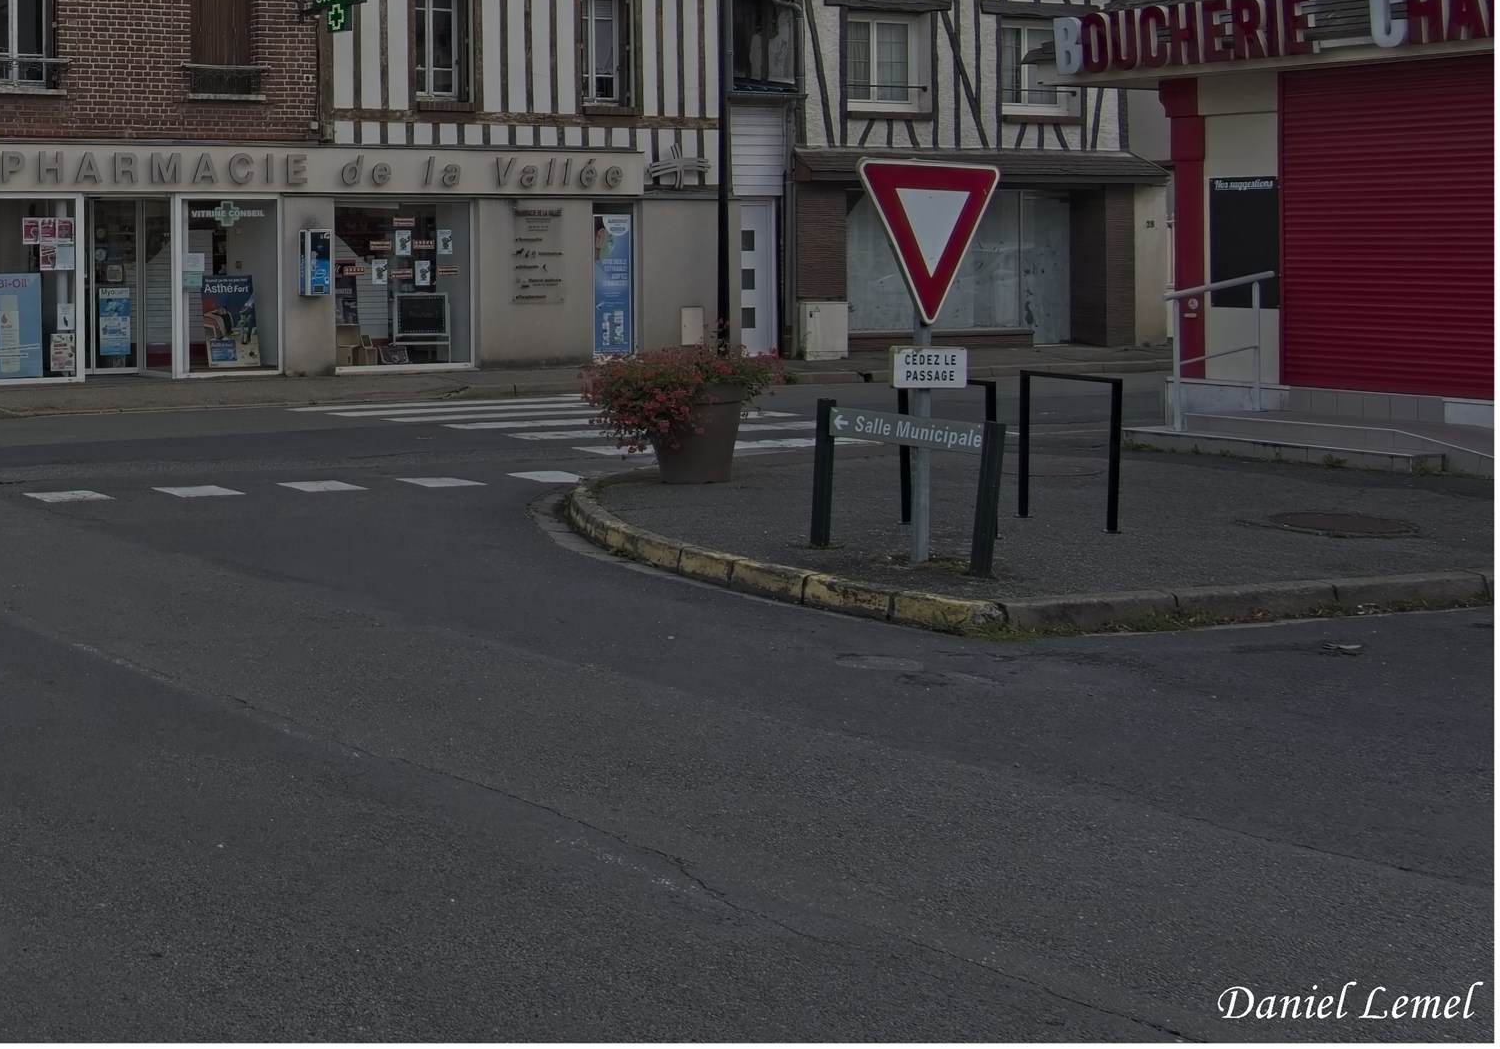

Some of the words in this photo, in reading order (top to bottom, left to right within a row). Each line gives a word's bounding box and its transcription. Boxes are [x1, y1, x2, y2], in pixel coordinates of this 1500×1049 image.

[0, 150, 308, 185] PHARMACIE
[341, 155, 391, 187] de
[421, 156, 461, 187] la
[495, 157, 624, 189] Vallée
[1214, 180, 1228, 189] Nos
[1229, 178, 1273, 190] suggestions
[191, 209, 226, 218] VITRINE
[228, 209, 266, 218] CONSEIL
[203, 283, 234, 294] Asthé
[944, 354, 957, 366] LE
[905, 370, 955, 382] PASSAGE
[854, 415, 891, 436] Salle
[895, 420, 983, 448] Municipale
